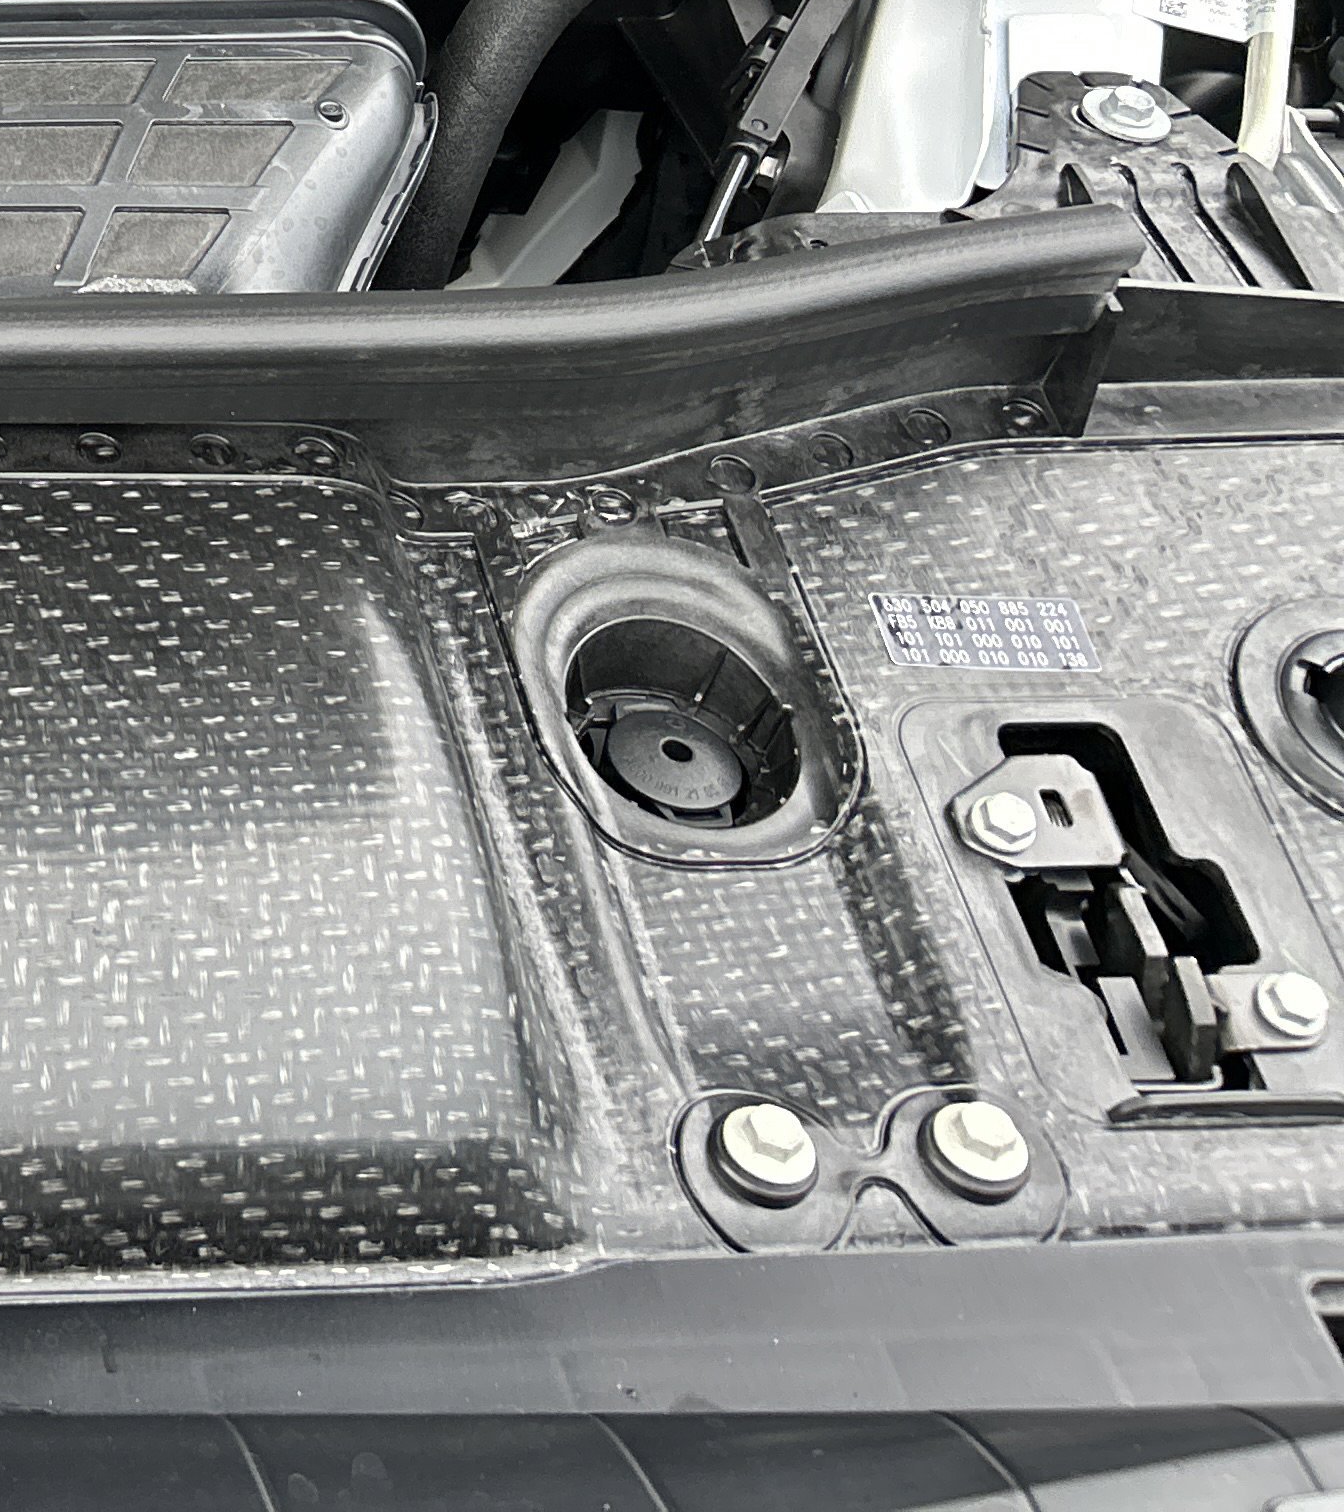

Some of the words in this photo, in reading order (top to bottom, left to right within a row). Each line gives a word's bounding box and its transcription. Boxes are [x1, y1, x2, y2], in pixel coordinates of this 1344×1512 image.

[883, 598, 913, 613] 630
[921, 599, 951, 614] 504
[960, 600, 990, 615] 050
[998, 601, 1028, 616] 885
[1037, 602, 1067, 617] 224
[966, 617, 995, 632] 011
[1005, 618, 1034, 632] 001
[1044, 619, 1073, 633] 001
[896, 631, 924, 646] 101
[935, 632, 963, 647] 101
[972, 633, 1003, 648] 000
[1011, 634, 1042, 649] 010
[1052, 635, 1080, 650] 101
[902, 648, 930, 663] 101
[939, 649, 970, 664] 000
[978, 650, 1009, 665] 010
[1017, 651, 1049, 666] 010
